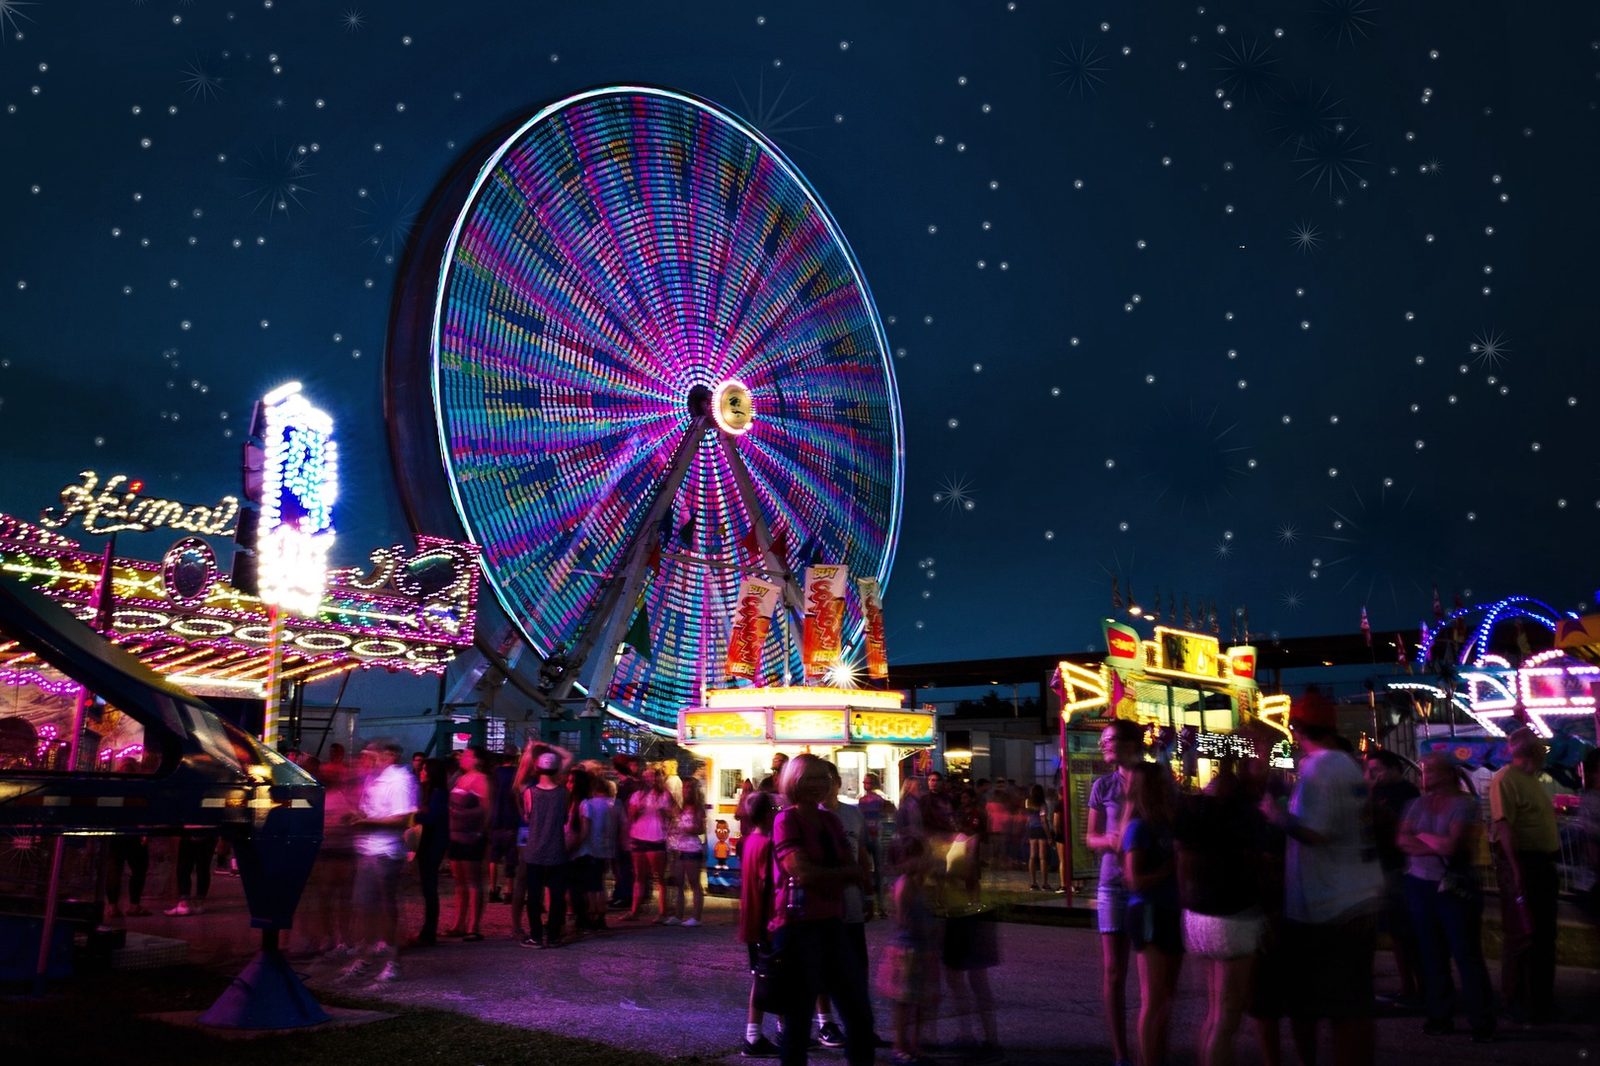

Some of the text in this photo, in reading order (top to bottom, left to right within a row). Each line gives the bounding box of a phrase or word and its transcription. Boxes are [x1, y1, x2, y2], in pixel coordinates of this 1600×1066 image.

[813, 567, 838, 579] BUY
[748, 585, 769, 598] BUY
[731, 662, 756, 676] HERE
[866, 715, 925, 738] TICKETS
